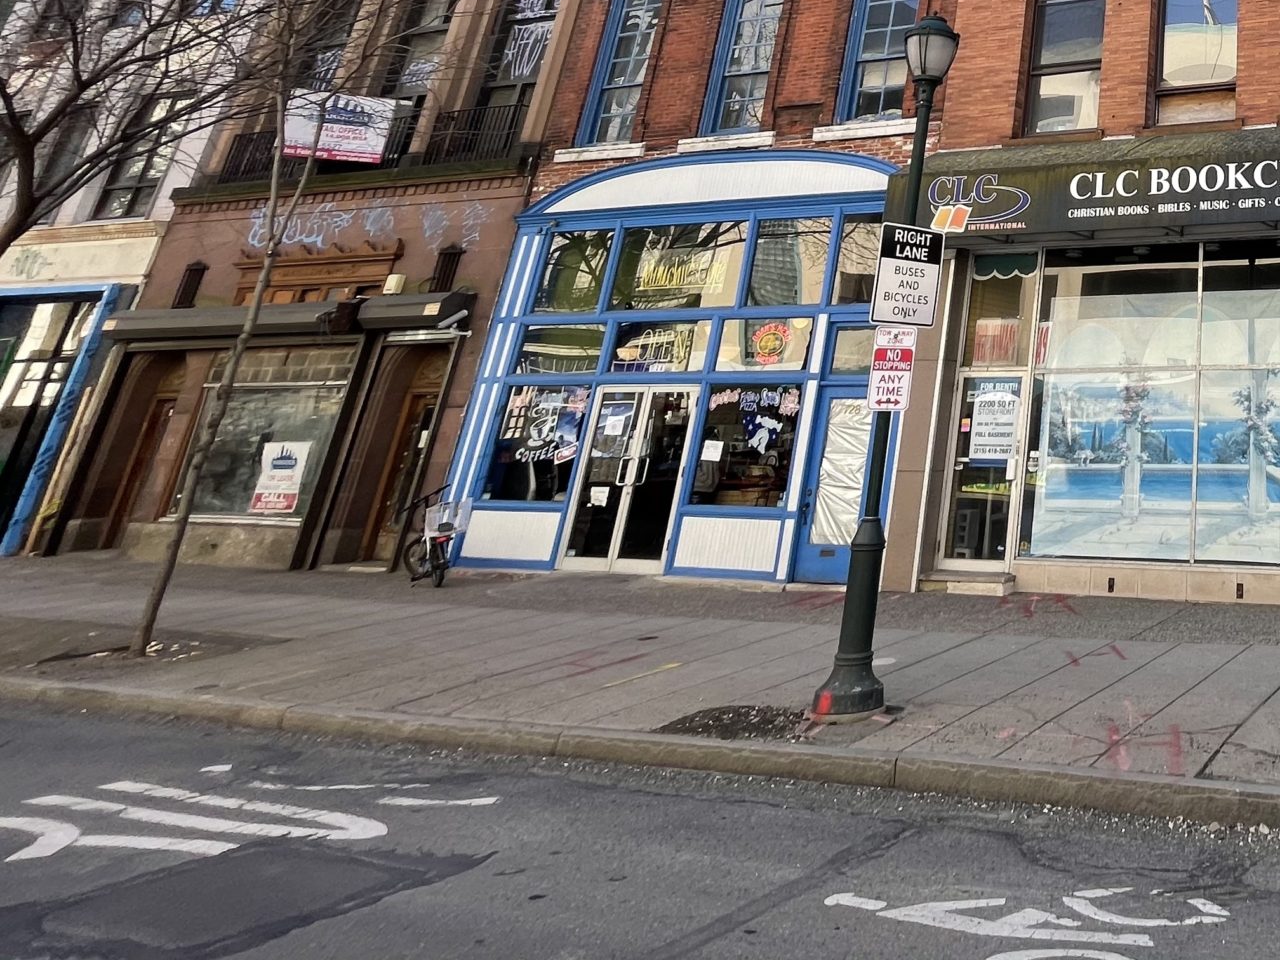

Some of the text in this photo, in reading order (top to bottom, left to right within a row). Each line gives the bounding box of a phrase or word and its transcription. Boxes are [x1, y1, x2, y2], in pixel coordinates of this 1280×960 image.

[928, 173, 999, 206] CLC
[1070, 169, 1140, 200] CLC
[1067, 207, 1115, 218] CHRISTIAN
[1117, 204, 1149, 216] BOOKS
[1157, 202, 1191, 213] BIBLES
[1199, 199, 1230, 210] MUSIC
[1237, 197, 1266, 209] GIFTS
[967, 221, 1027, 231] INTERNATIONAL
[894, 229, 933, 246] RIGHT
[895, 244, 929, 260] LANE
[894, 265, 926, 278] BUSES
[898, 280, 920, 290] AND
[883, 292, 929, 305] BICYCLES
[892, 306, 918, 317] ONLY
[886, 349, 901, 362] NO
[873, 360, 911, 370] STOPPING
[878, 374, 905, 384] ANY
[875, 386, 903, 397] TIME
[980, 382, 994, 391] FOR
[977, 408, 1015, 416] STOREFRONT
[514, 442, 557, 463] COFFEE
